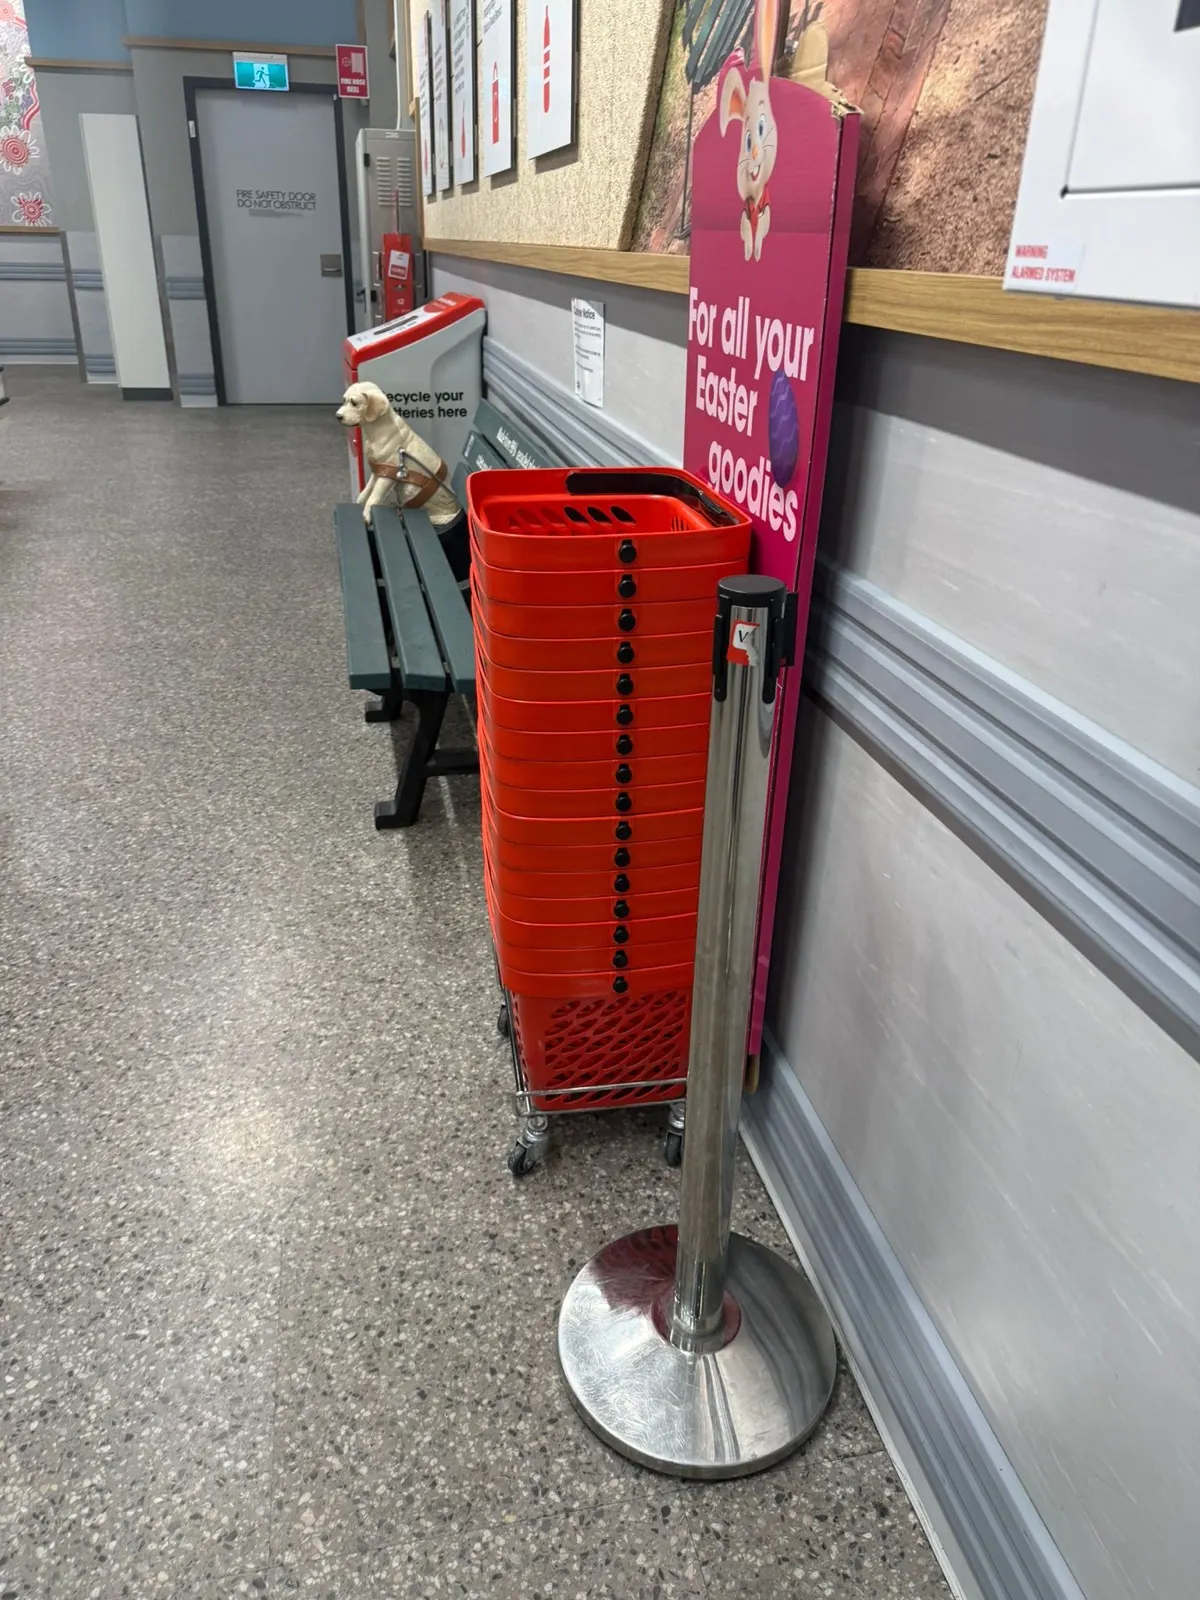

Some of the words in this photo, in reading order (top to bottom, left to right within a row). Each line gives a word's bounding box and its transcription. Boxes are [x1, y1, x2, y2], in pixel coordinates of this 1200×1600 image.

[236, 189, 253, 199] FIRE
[255, 190, 286, 200] SAFETY
[288, 192, 317, 202] DOOR
[237, 199, 253, 208] DO
[253, 200, 272, 209] NOT
[273, 201, 316, 210] OBSTRUCT
[1015, 244, 1049, 259] WARNING
[1011, 265, 1045, 281] ALARMED
[1045, 268, 1076, 282] SYSTEM
[688, 286, 717, 349] For
[721, 295, 750, 361] all
[754, 314, 815, 382] your
[384, 391, 431, 405] ecycle
[434, 391, 464, 405] your
[695, 355, 759, 438] Easter
[437, 406, 468, 418] here
[707, 440, 799, 543] goodies
